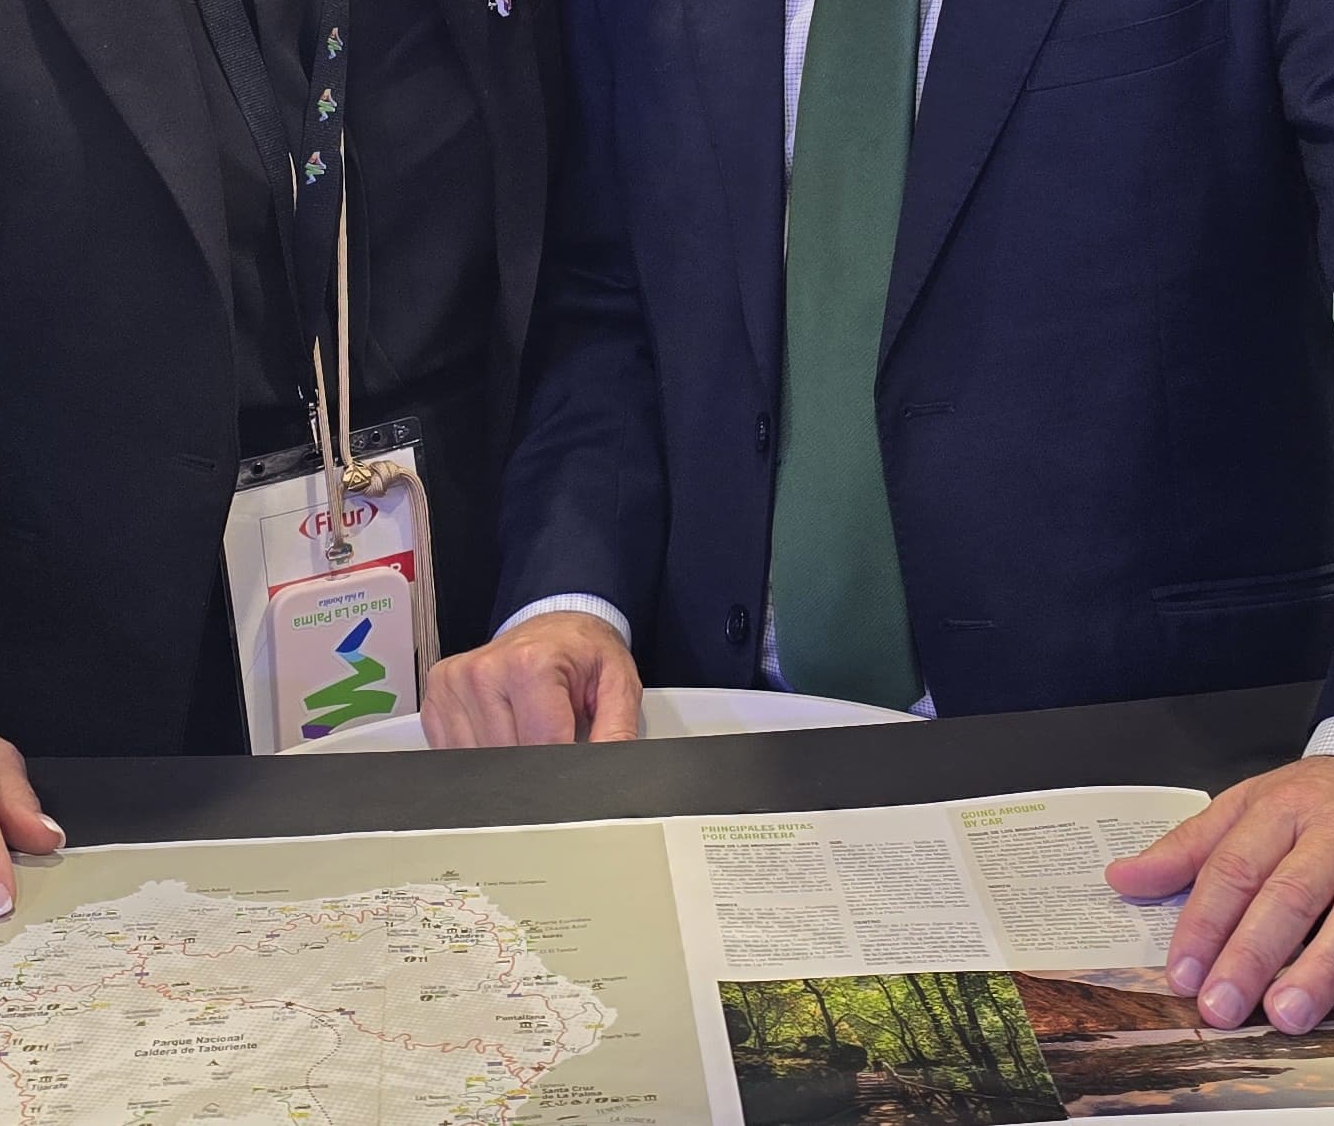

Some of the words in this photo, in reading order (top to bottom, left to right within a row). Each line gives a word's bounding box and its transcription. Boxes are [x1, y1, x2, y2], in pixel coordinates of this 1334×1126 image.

[315, 507, 365, 535] Fiur
[352, 602, 368, 615] de
[371, 597, 392, 610] Isla
[293, 610, 332, 627] Palma
[335, 607, 349, 618] La
[961, 809, 996, 820] GOING
[999, 803, 1046, 815] AROUND
[701, 824, 776, 833] PRINCIPALES
[778, 823, 814, 831] RUTAS
[963, 820, 978, 828] BY
[981, 817, 1004, 827] CAR
[702, 833, 727, 841] POR
[729, 832, 796, 841] CARRETERA
[152, 1037, 192, 1047] Parque
[196, 1034, 244, 1044] Nacional
[134, 1048, 178, 1057] Caldera
[180, 1046, 195, 1054] de
[198, 1041, 258, 1053] Taburiente
[541, 1086, 567, 1094] Santa
[571, 1090, 603, 1098] Palma
